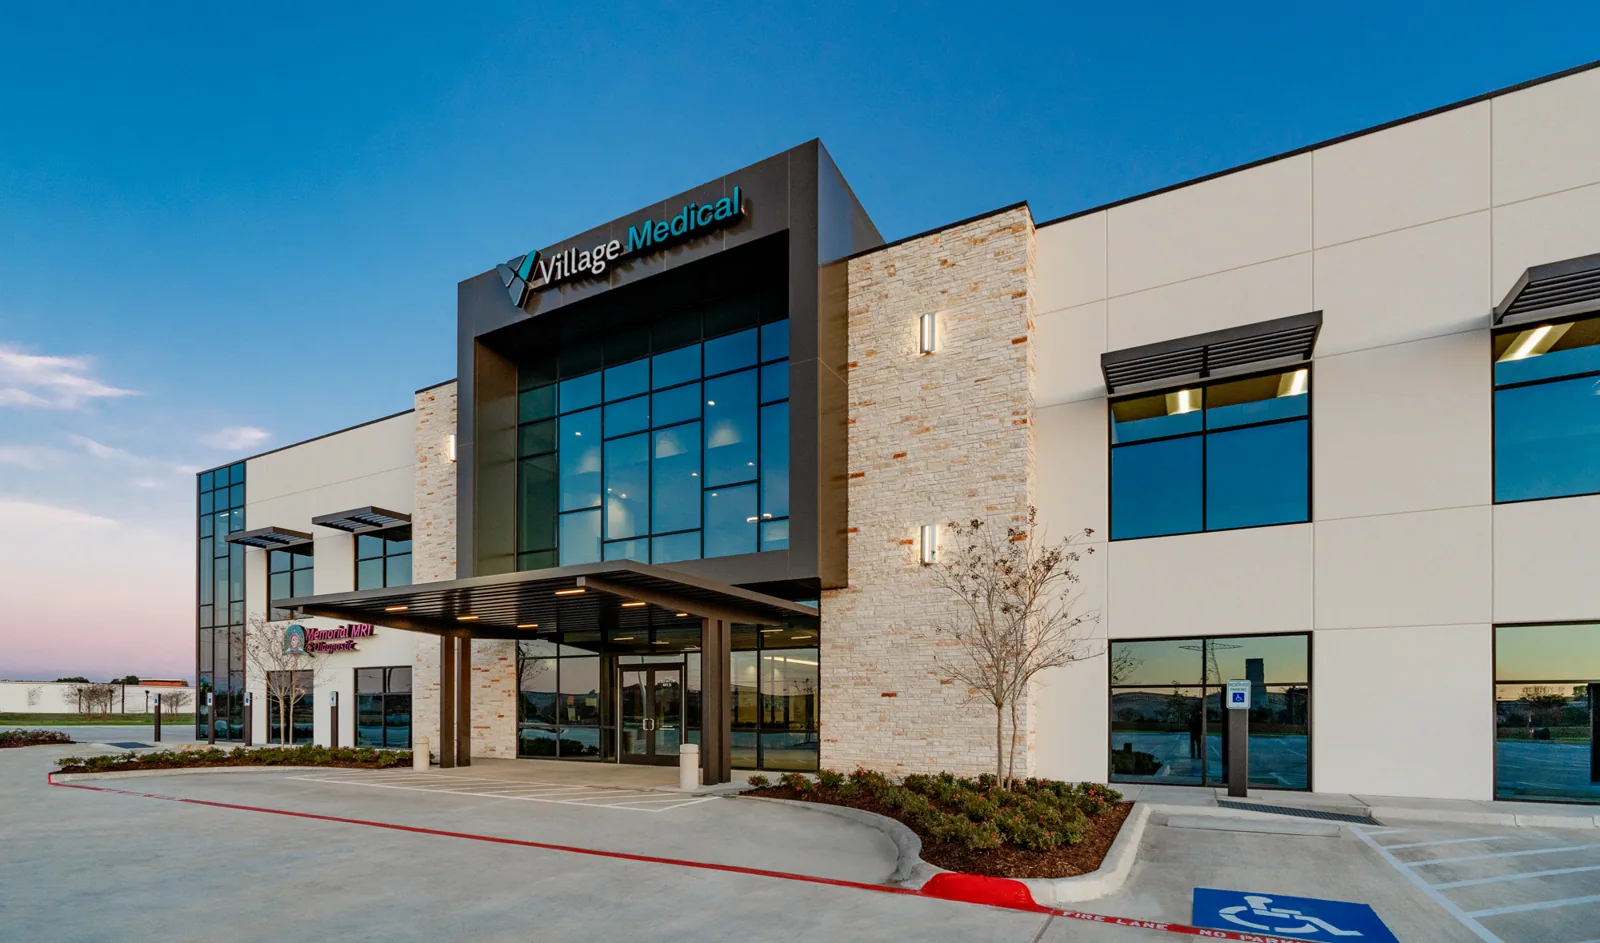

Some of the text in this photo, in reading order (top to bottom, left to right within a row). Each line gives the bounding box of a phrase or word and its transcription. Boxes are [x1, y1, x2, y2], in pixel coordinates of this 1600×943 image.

[540, 186, 740, 284] Village Medical
[306, 624, 371, 640] Memorial MRI
[314, 640, 353, 652] Diagnostic
[1063, 911, 1106, 922] FIRE
[1116, 919, 1168, 931] LANE
[1199, 929, 1227, 938] NO
